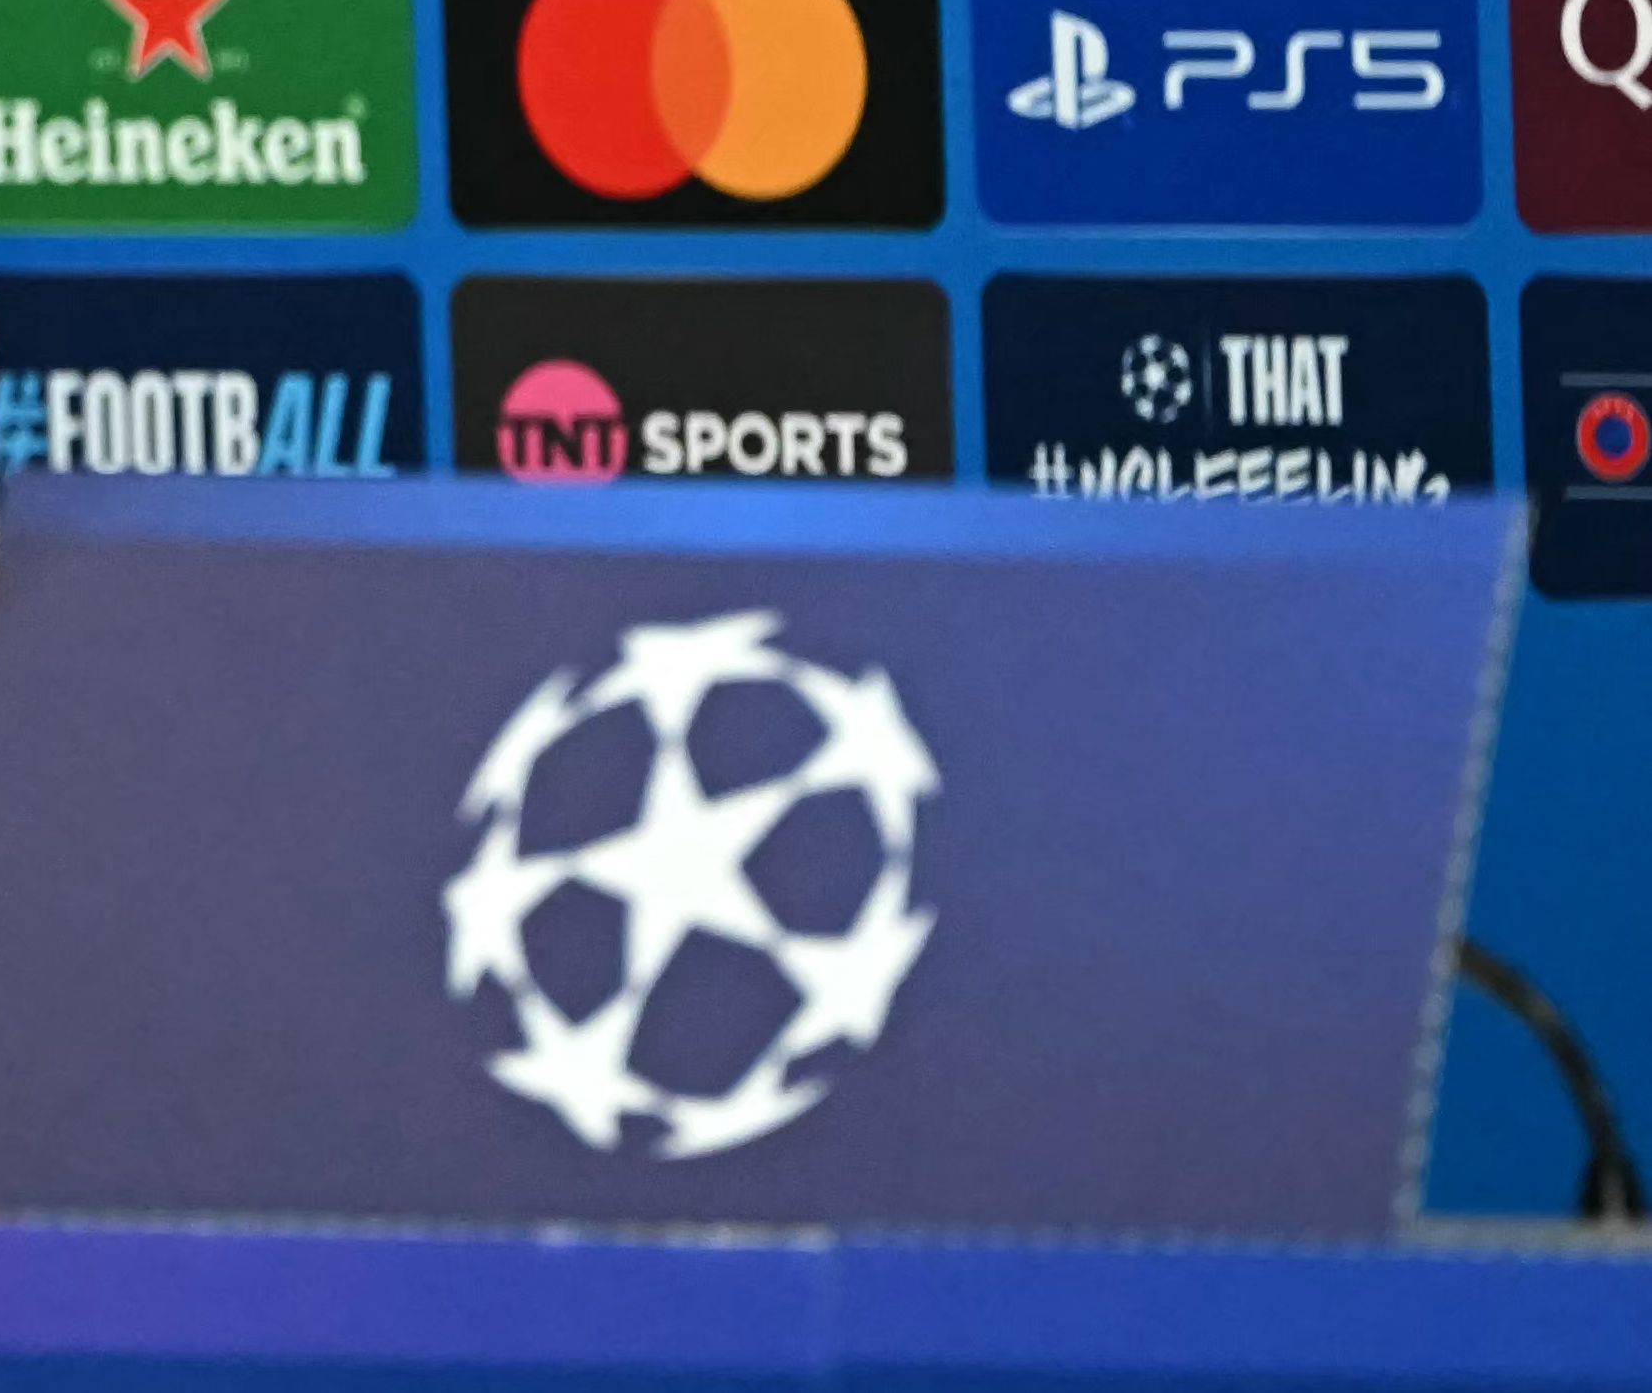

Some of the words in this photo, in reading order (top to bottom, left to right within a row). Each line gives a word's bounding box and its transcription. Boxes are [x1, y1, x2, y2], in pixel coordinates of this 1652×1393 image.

[1163, 30, 1445, 111] PS5
[1219, 333, 1350, 428] THAT
[641, 409, 909, 478] SPORTS
